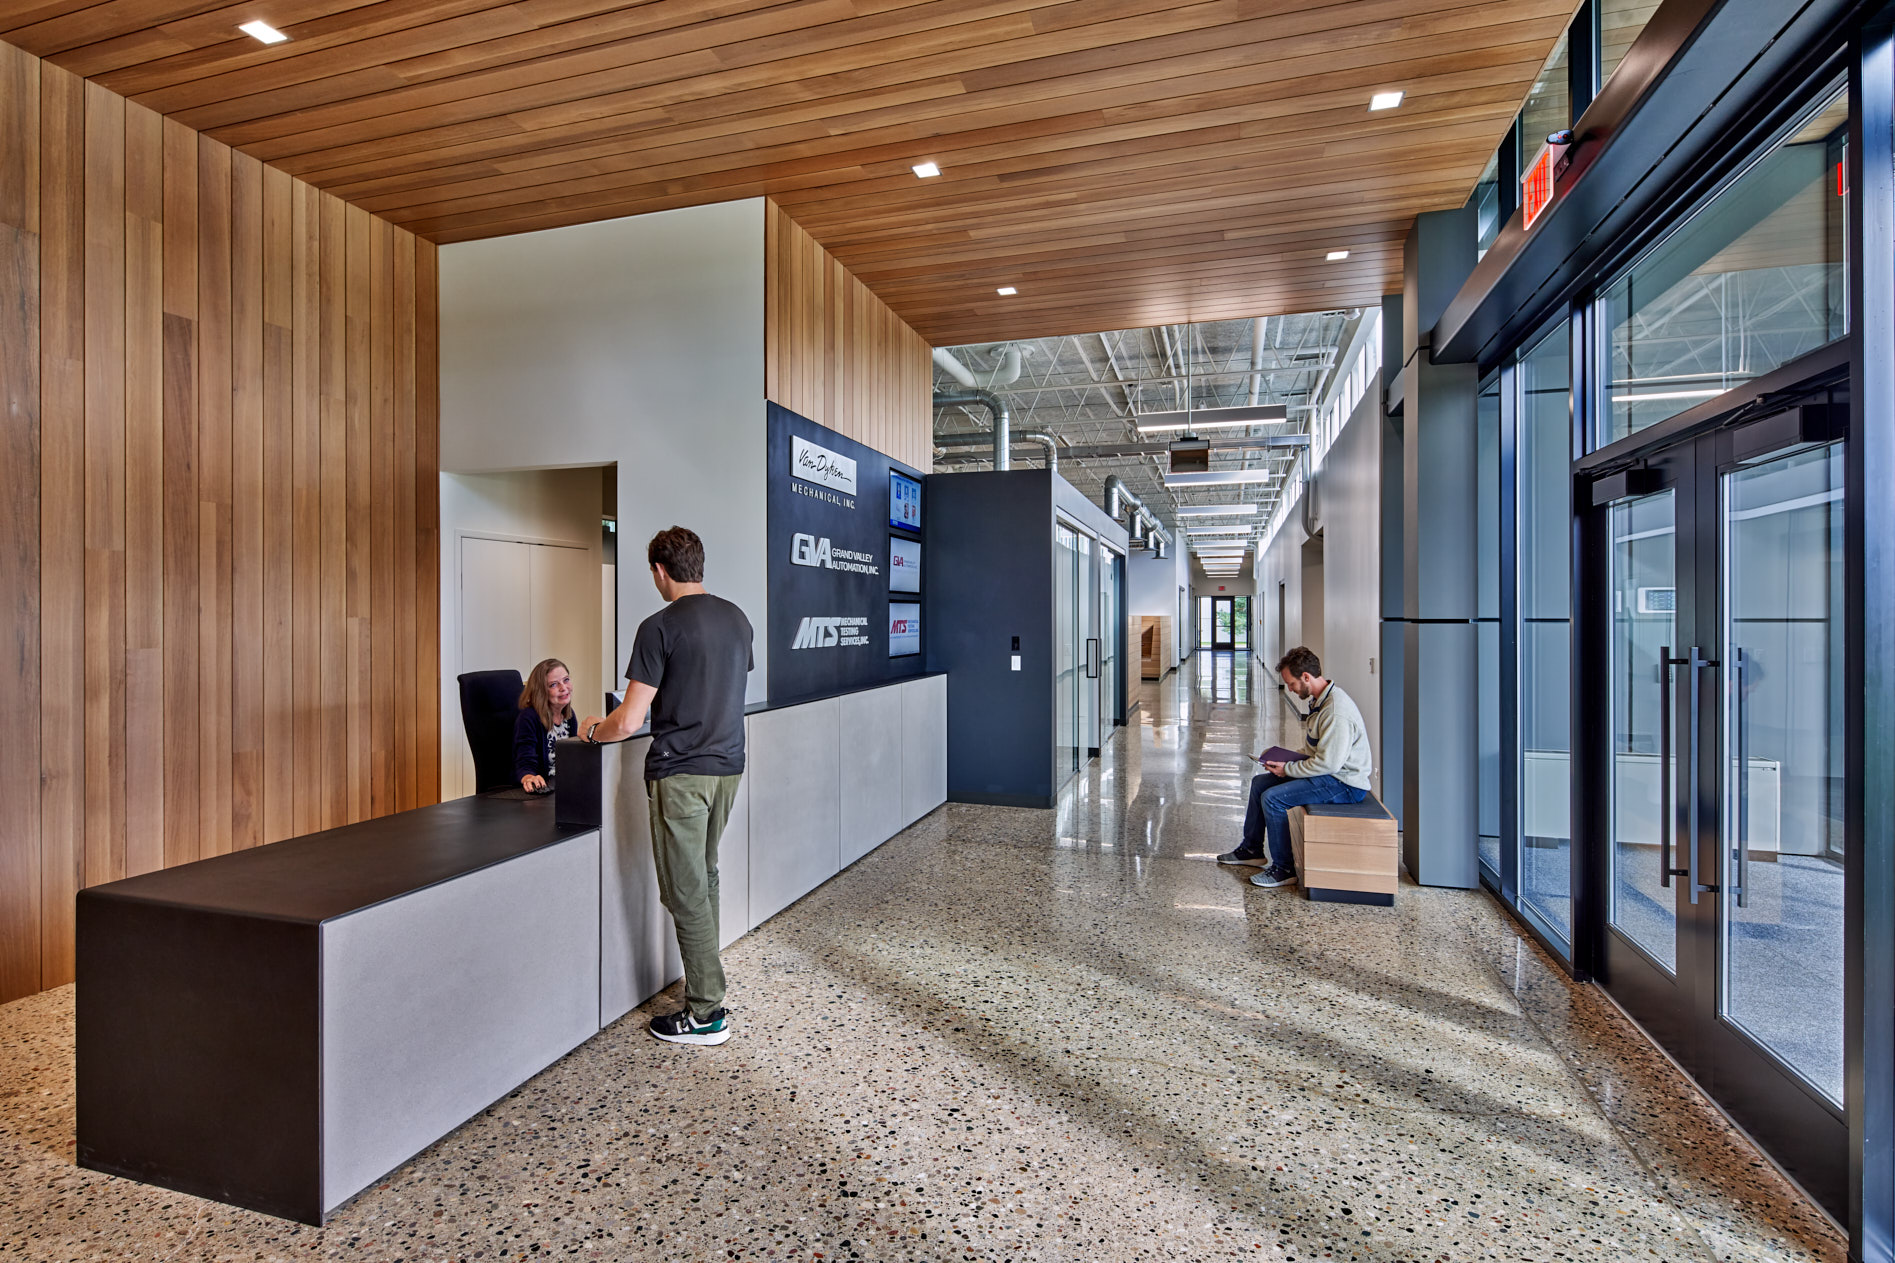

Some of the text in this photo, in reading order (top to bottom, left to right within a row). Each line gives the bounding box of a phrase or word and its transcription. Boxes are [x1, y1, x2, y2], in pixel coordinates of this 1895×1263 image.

[1527, 152, 1549, 224] EXIT
[799, 449, 852, 483] Van Dyken
[792, 482, 856, 510] MECHANICAL, INC.
[791, 532, 833, 569] GVA
[832, 547, 873, 563] GRAND VALLEY
[791, 616, 841, 650] MTS
[890, 619, 908, 635] MTS
